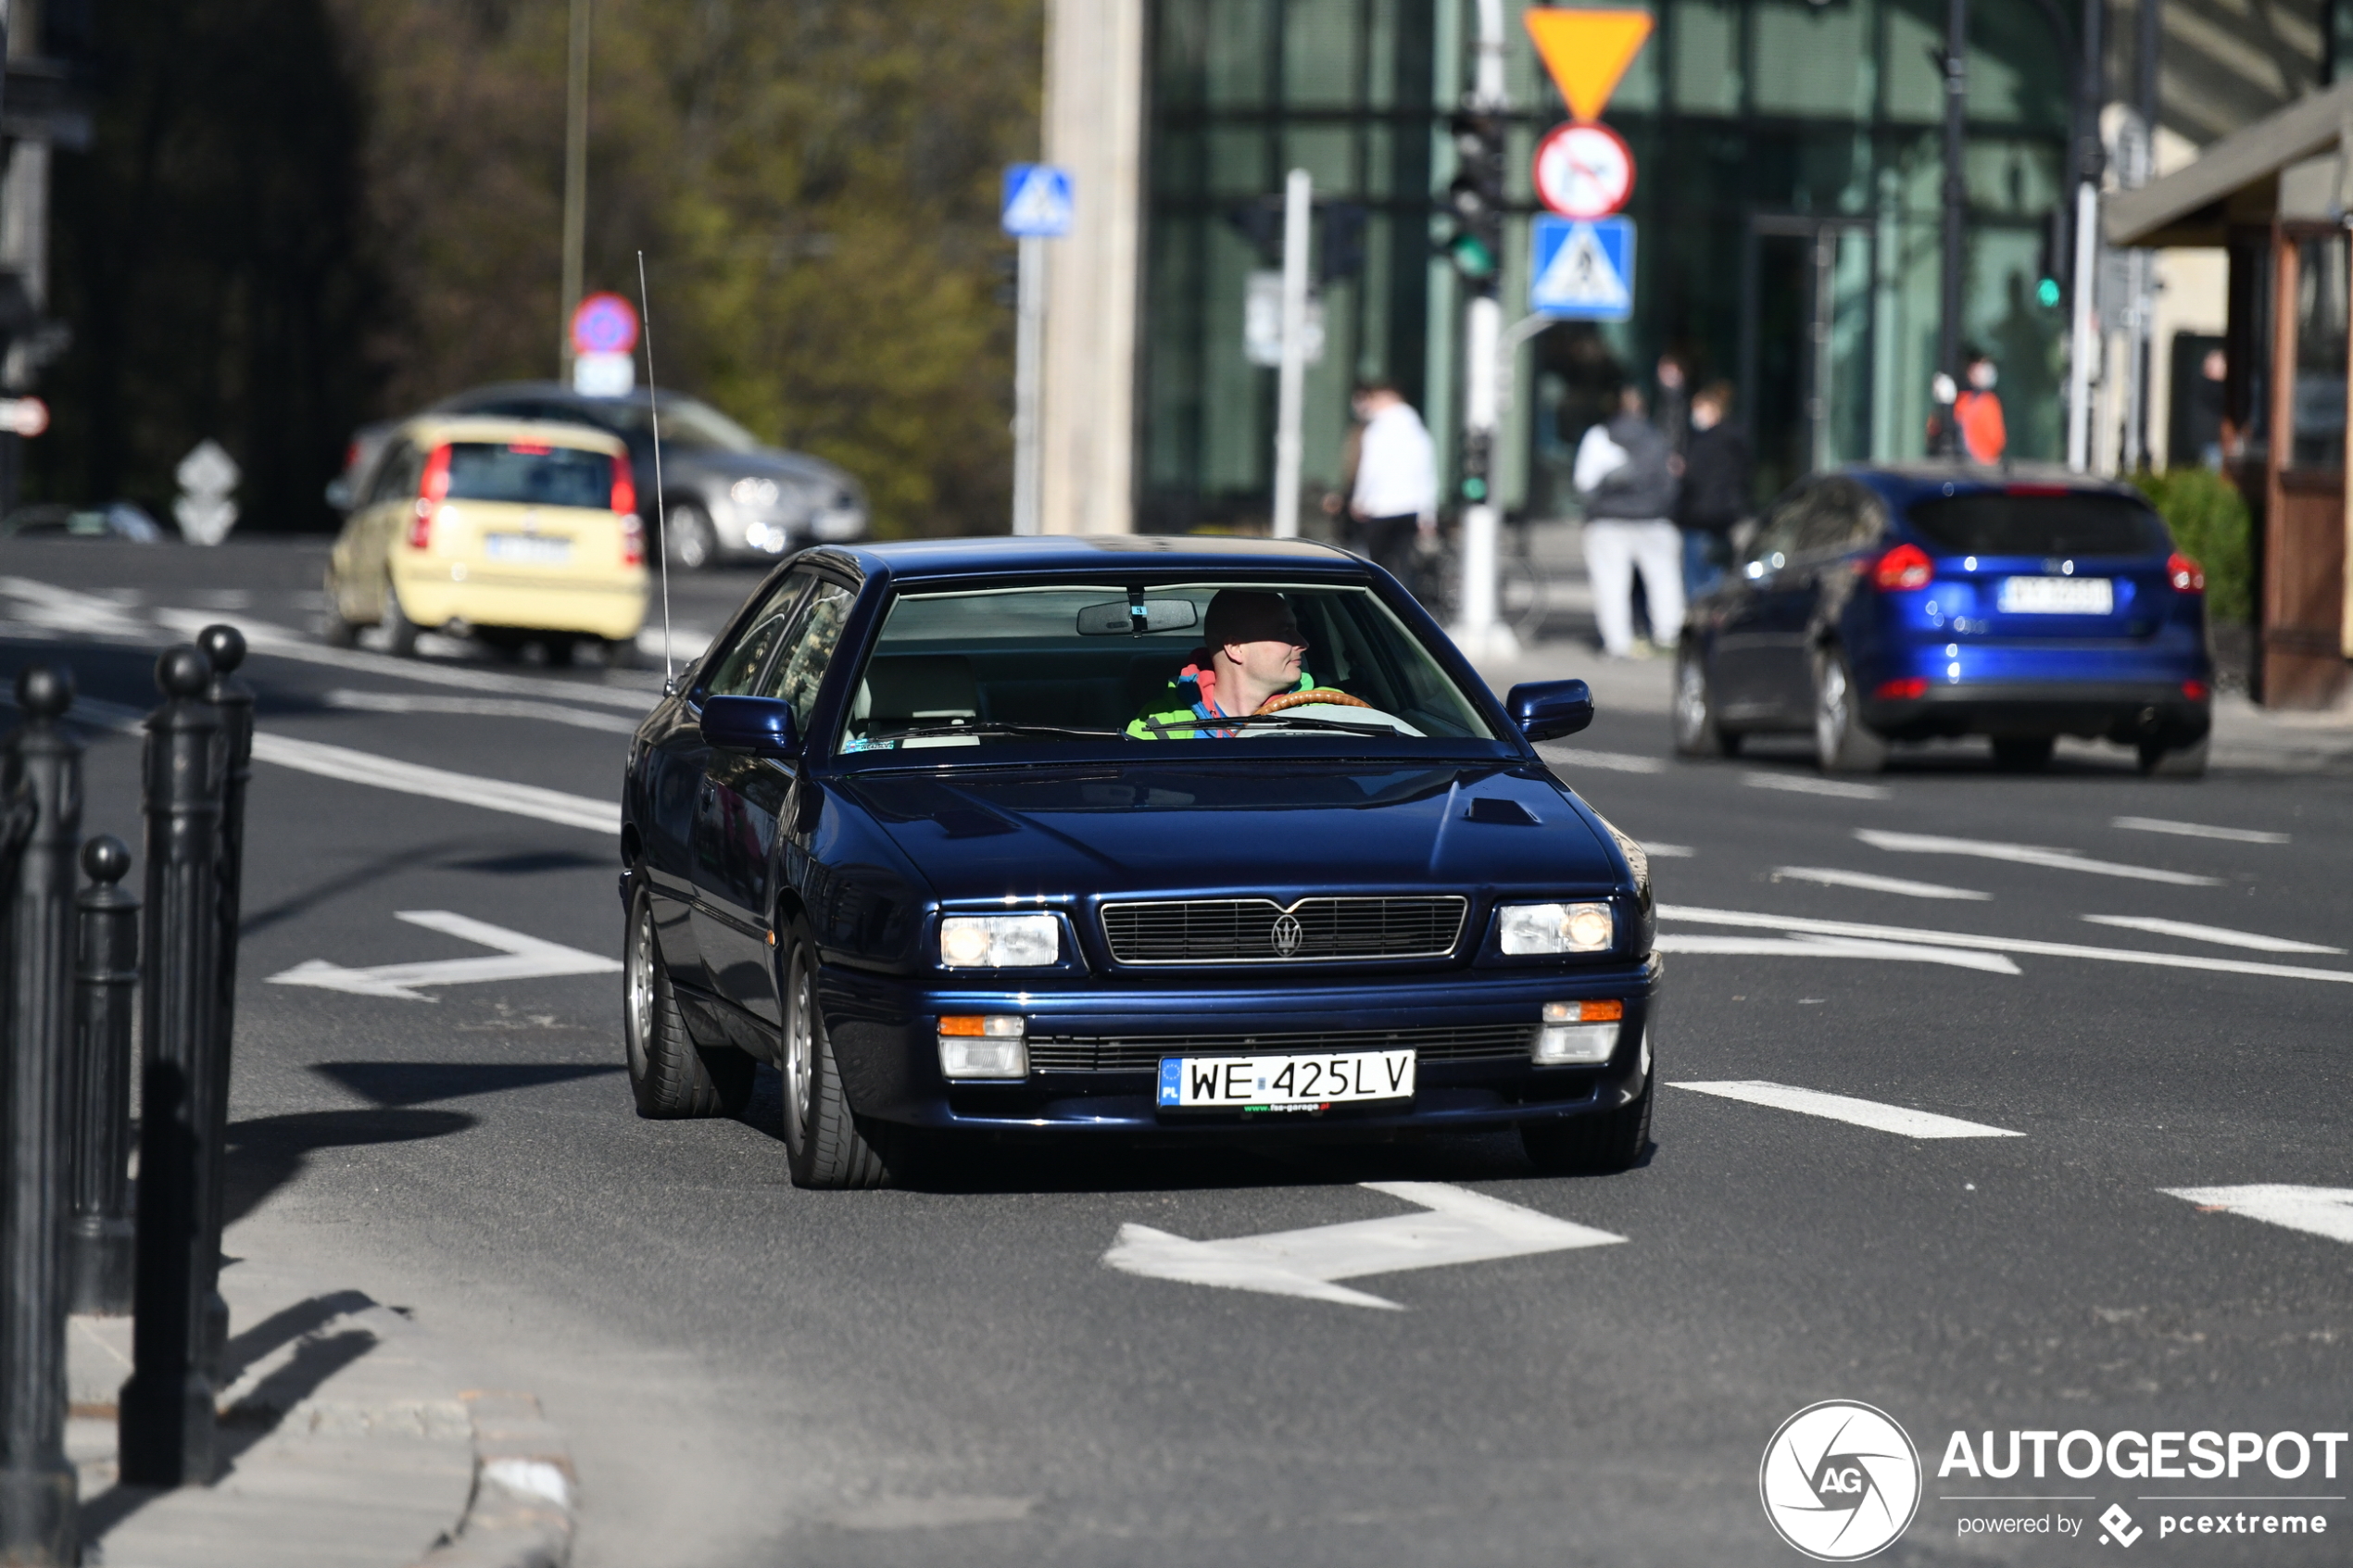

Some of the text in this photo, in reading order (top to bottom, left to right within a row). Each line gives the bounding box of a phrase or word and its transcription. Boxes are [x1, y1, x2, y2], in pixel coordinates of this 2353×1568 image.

[1191, 1056, 1408, 1099] WE 425LV
[1163, 1087, 1178, 1098] PL
